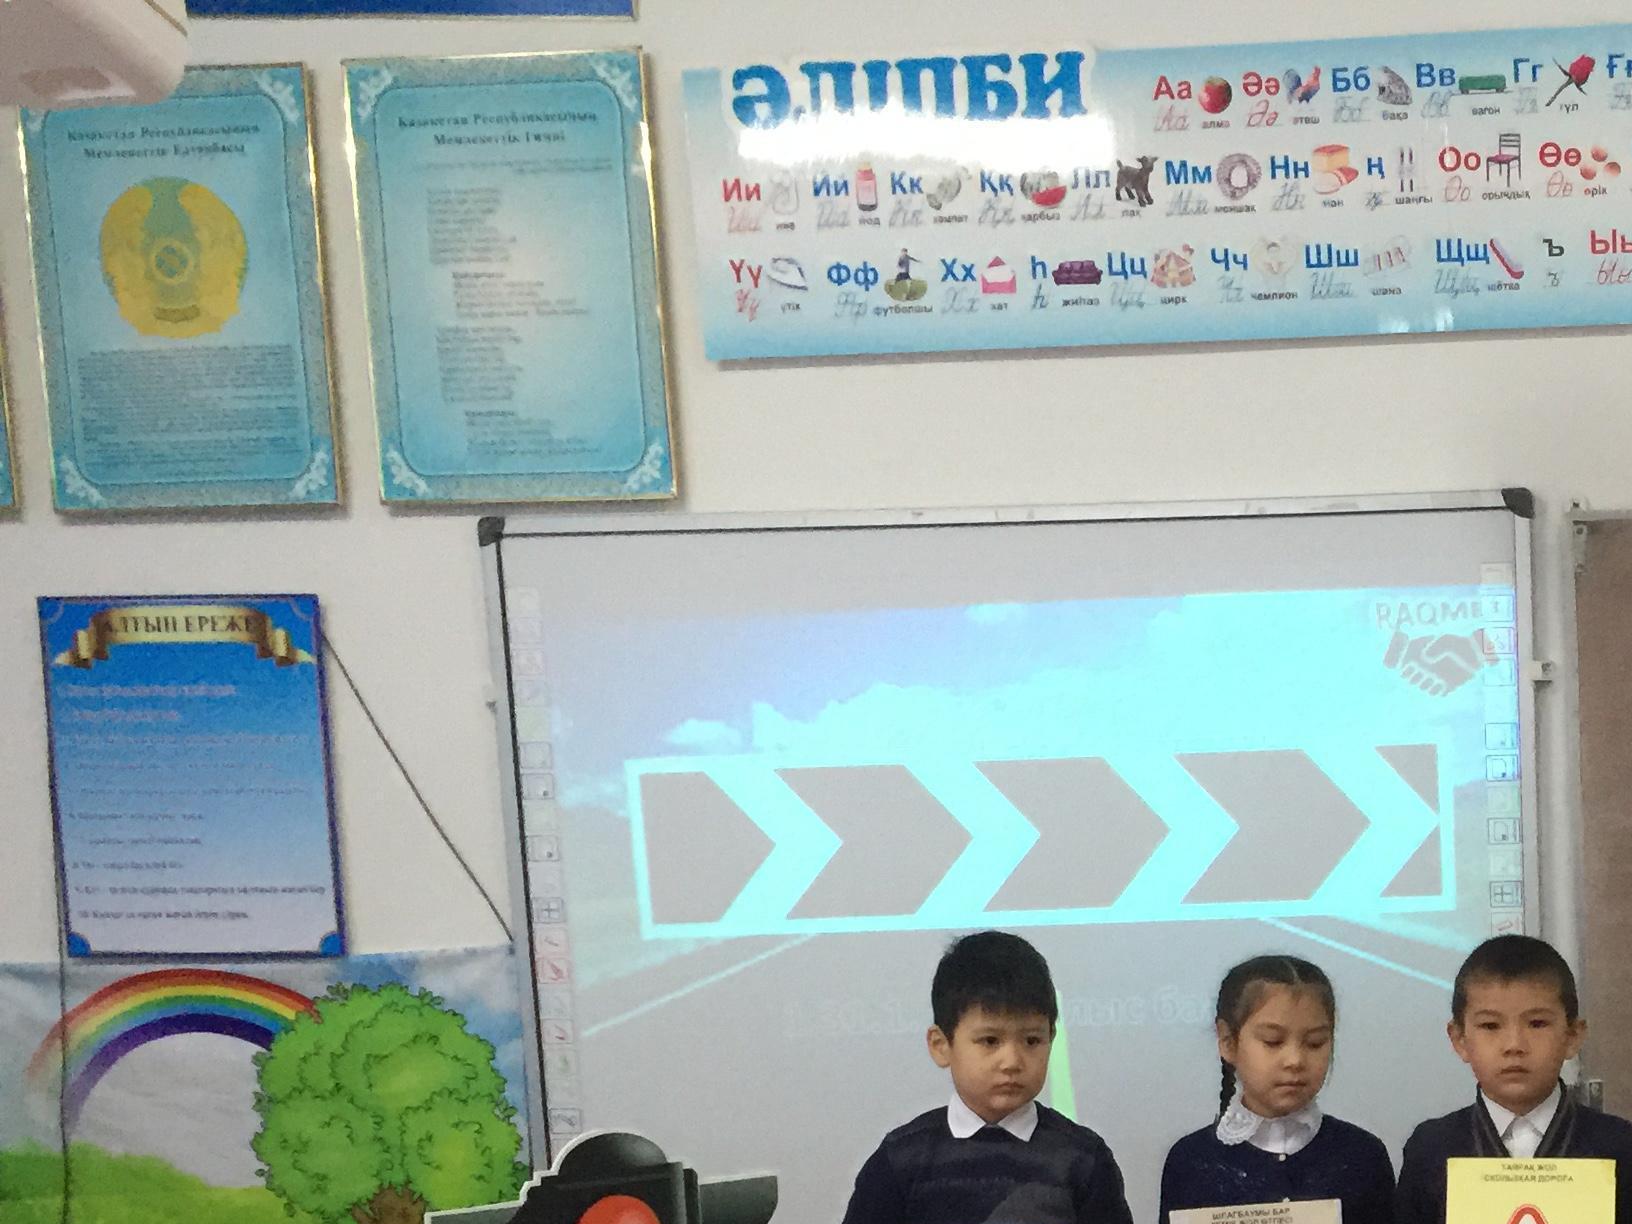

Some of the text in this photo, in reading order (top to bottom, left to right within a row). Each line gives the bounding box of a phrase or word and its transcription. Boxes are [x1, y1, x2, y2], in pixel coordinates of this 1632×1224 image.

[1242, 71, 1280, 96] Әә
[1331, 66, 1371, 93] Бб
[1416, 62, 1456, 89] Вв
[1513, 58, 1544, 83] Гг
[1153, 74, 1193, 101] Аа
[1270, 155, 1310, 180] Нн
[1439, 146, 1481, 172] Оо
[1539, 142, 1581, 168] Өө
[891, 171, 923, 195] Кк
[1165, 160, 1212, 186] Мм
[722, 176, 761, 203] Ии
[1211, 248, 1248, 272] Чч
[1305, 243, 1359, 269] Шш
[1435, 238, 1489, 266] Щщ
[827, 261, 879, 291] Фф
[941, 257, 976, 283] Хх
[1107, 251, 1147, 284] Цц
